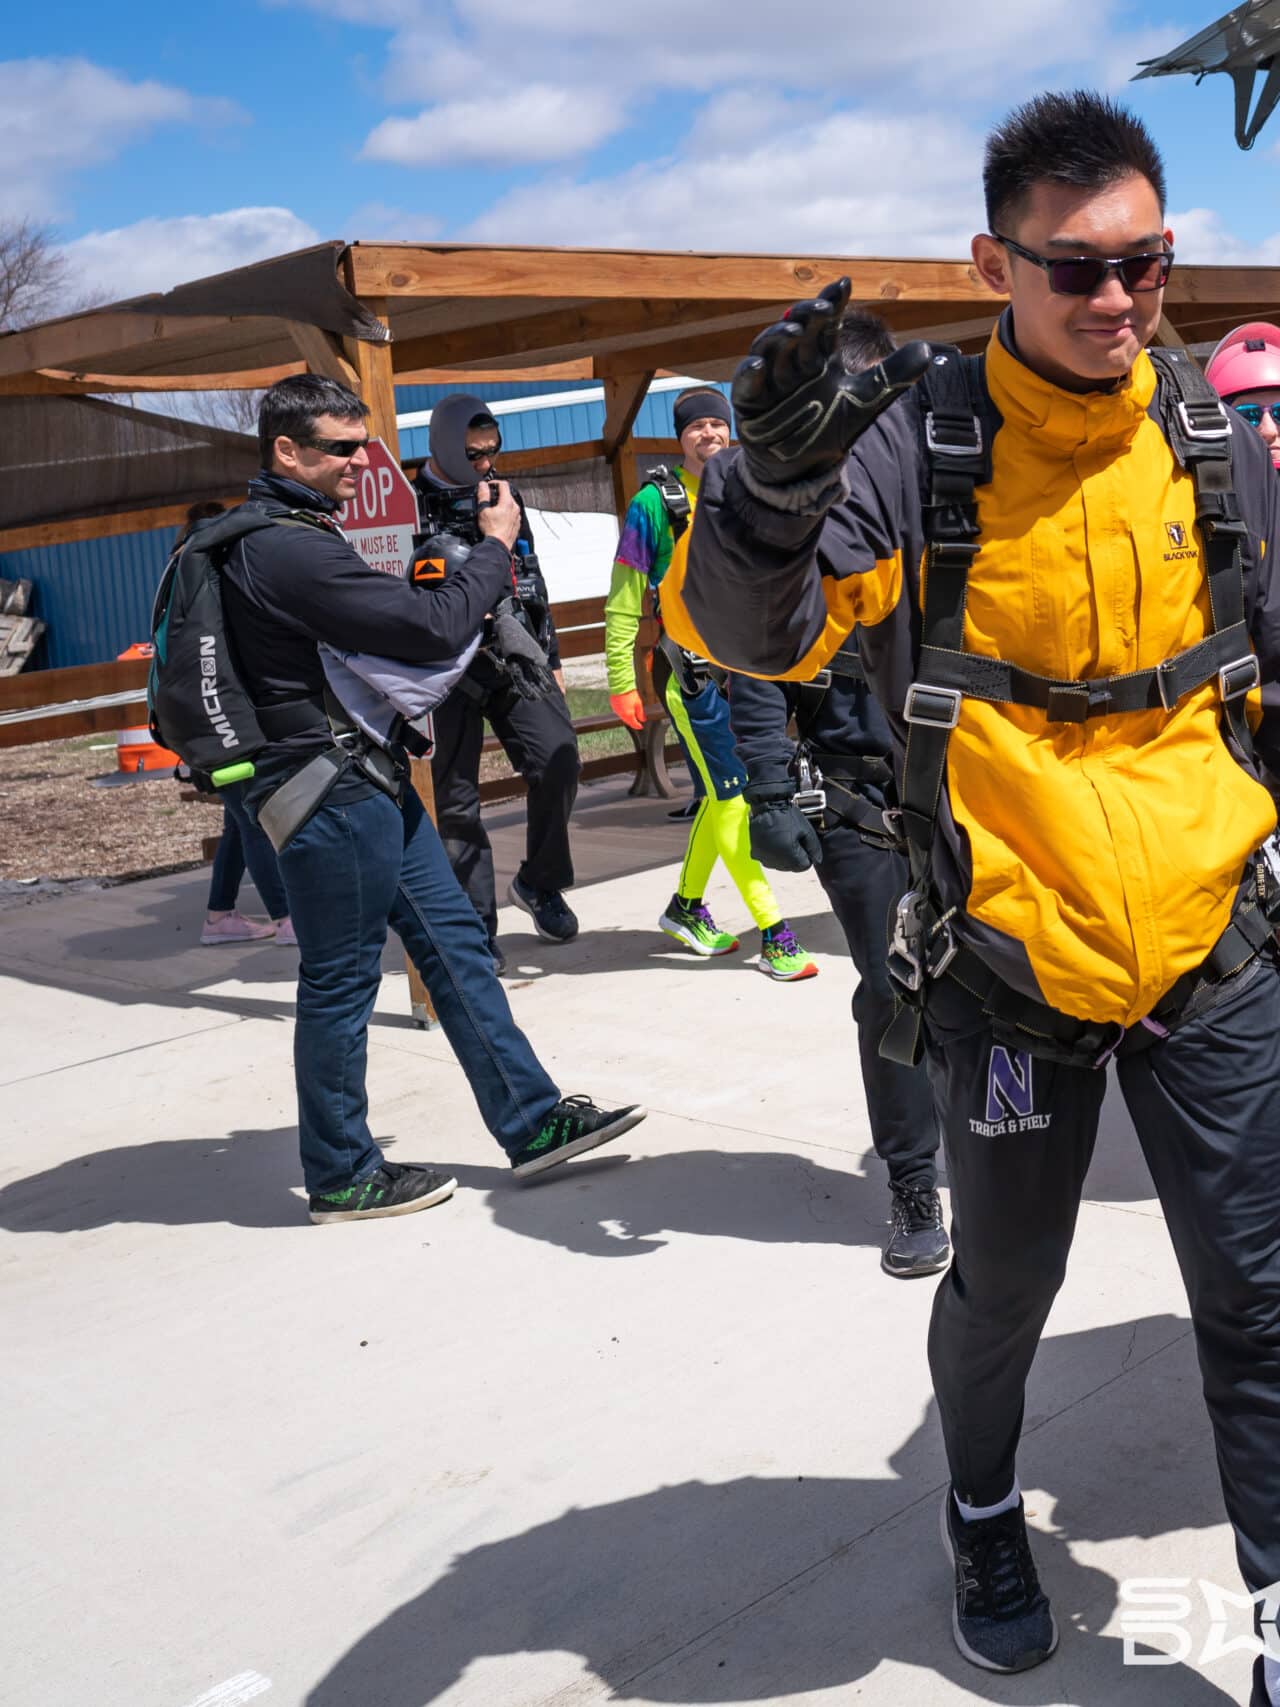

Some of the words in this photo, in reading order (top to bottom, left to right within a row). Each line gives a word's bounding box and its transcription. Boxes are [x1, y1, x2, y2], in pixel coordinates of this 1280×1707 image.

[361, 535, 386, 555] MUST
[386, 534, 399, 553] BE
[200, 636, 239, 748] MICRON
[986, 1045, 1033, 1121] N
[969, 1118, 1007, 1137] TRACK
[1007, 1119, 1017, 1133] &
